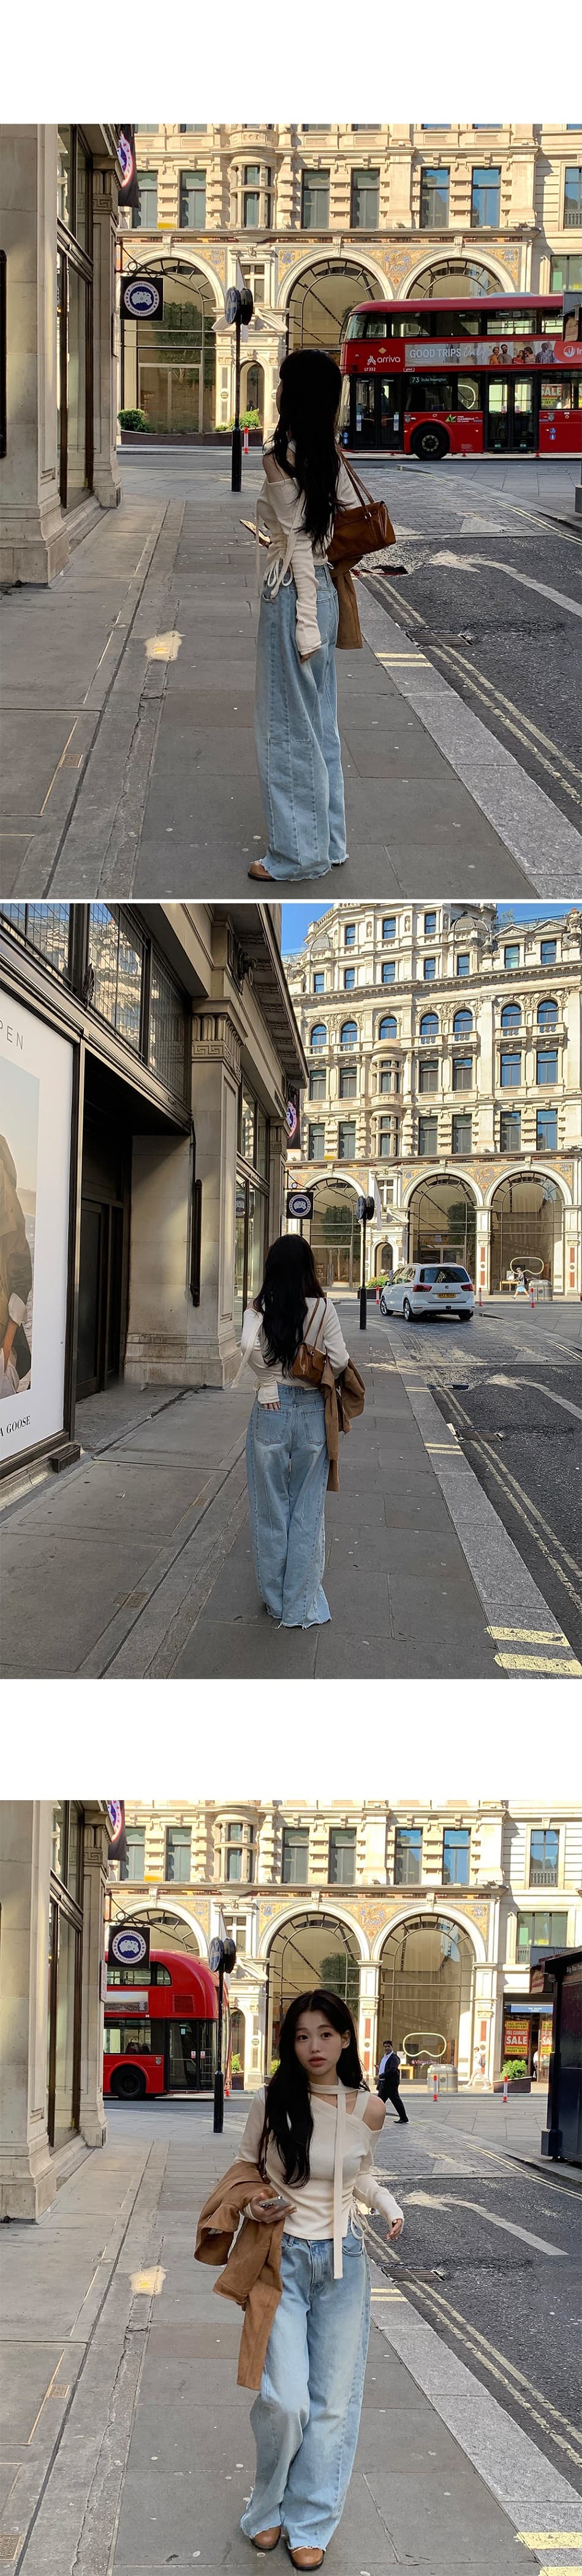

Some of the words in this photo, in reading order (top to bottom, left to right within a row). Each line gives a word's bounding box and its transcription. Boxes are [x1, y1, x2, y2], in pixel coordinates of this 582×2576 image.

[410, 350, 436, 358] GOOD
[436, 348, 461, 358] TRIPS
[6, 1415, 31, 1434] GOOSE
[506, 2036, 527, 2045] SALE
